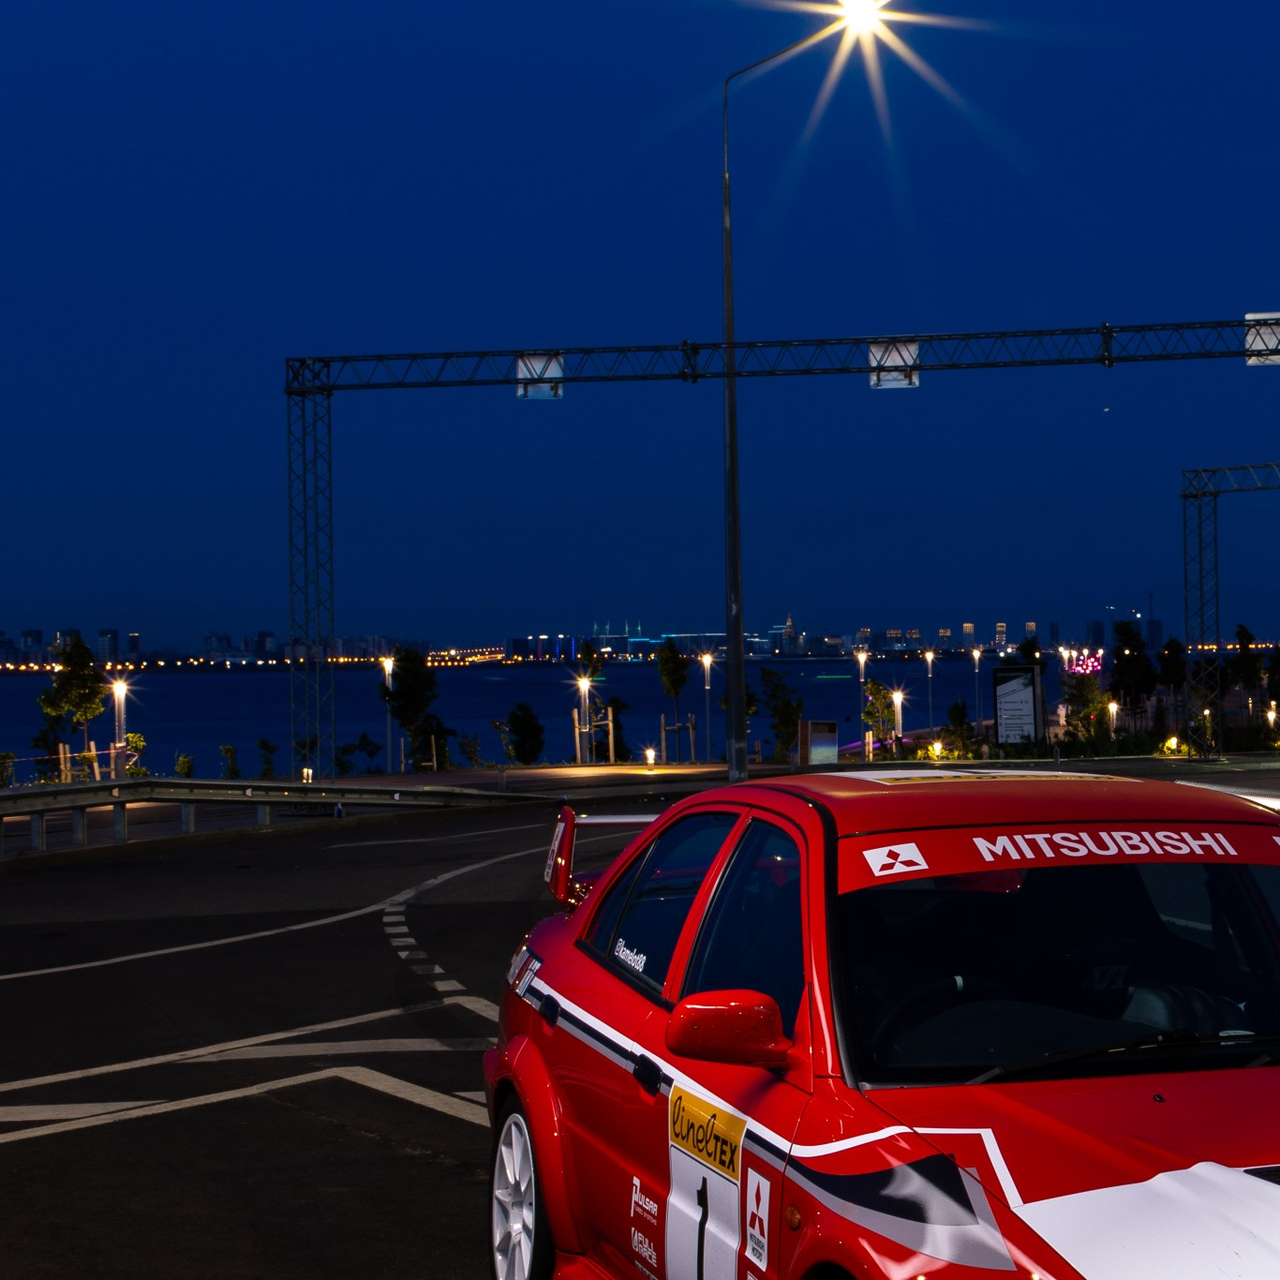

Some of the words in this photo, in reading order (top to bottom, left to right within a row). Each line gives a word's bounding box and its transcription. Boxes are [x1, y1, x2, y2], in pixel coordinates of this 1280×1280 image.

[973, 831, 1238, 862] MITSUBISHI
[630, 1176, 658, 1217] PULSAR
[637, 1231, 656, 1255] FULL
[637, 1242, 657, 1267] RACE
